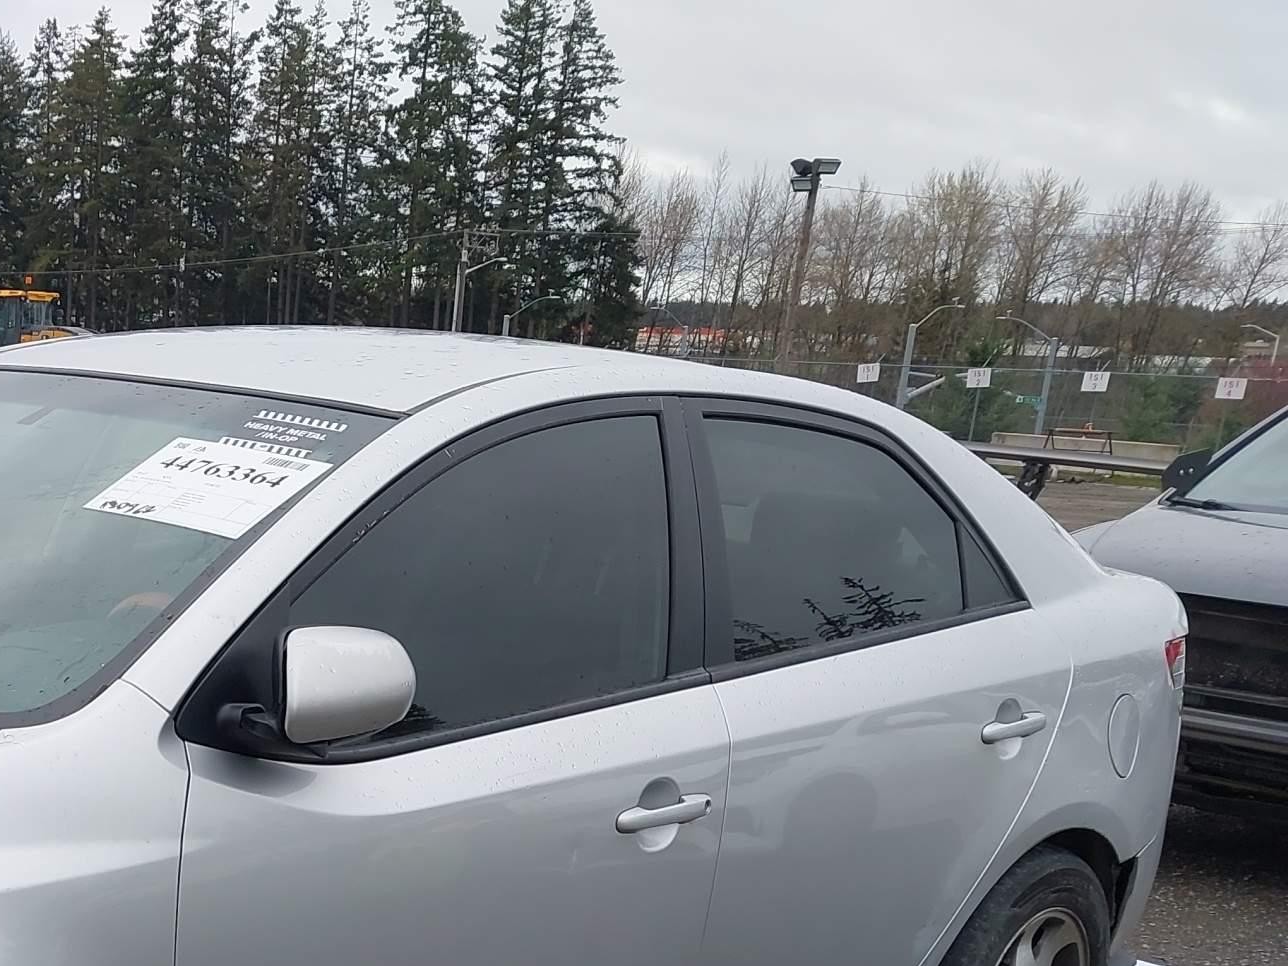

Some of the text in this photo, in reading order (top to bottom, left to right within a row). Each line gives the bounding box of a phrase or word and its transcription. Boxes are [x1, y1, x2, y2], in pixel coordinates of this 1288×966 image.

[243, 421, 328, 441] HEAVY METAL
[255, 431, 299, 443] /IN-OP
[160, 455, 289, 488] 44763364
